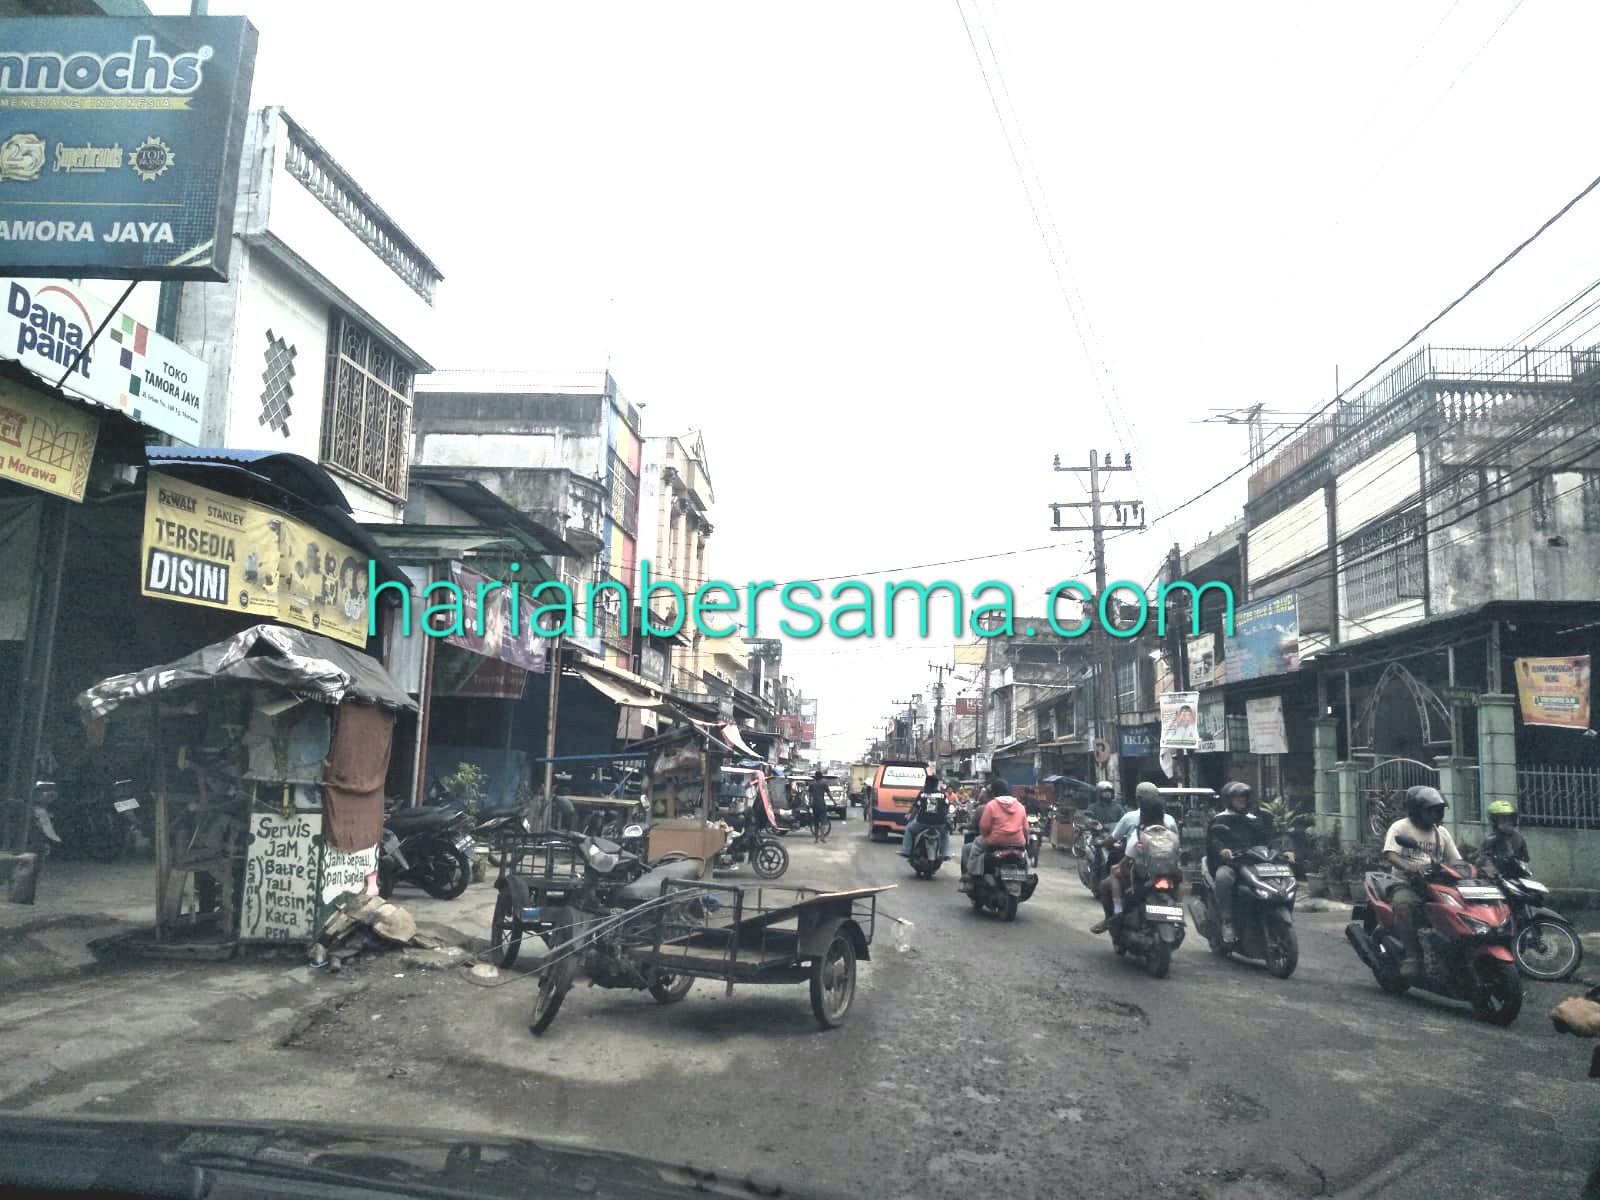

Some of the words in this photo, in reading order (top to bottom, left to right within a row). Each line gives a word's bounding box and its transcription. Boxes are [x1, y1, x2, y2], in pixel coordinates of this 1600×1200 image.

[103, 222, 174, 243] JAYA
[7, 281, 83, 350] Dana
[17, 322, 92, 379] paint
[163, 361, 188, 384] TOKO
[145, 369, 180, 400] TAMORA
[181, 389, 200, 410] JAYA
[8, 456, 57, 484] Morawa
[207, 505, 244, 527] STANLEY
[155, 517, 236, 563] TERSEDIA
[149, 552, 226, 601] DISINI
[256, 817, 311, 839] Servis
[265, 891, 306, 910] Mesin
